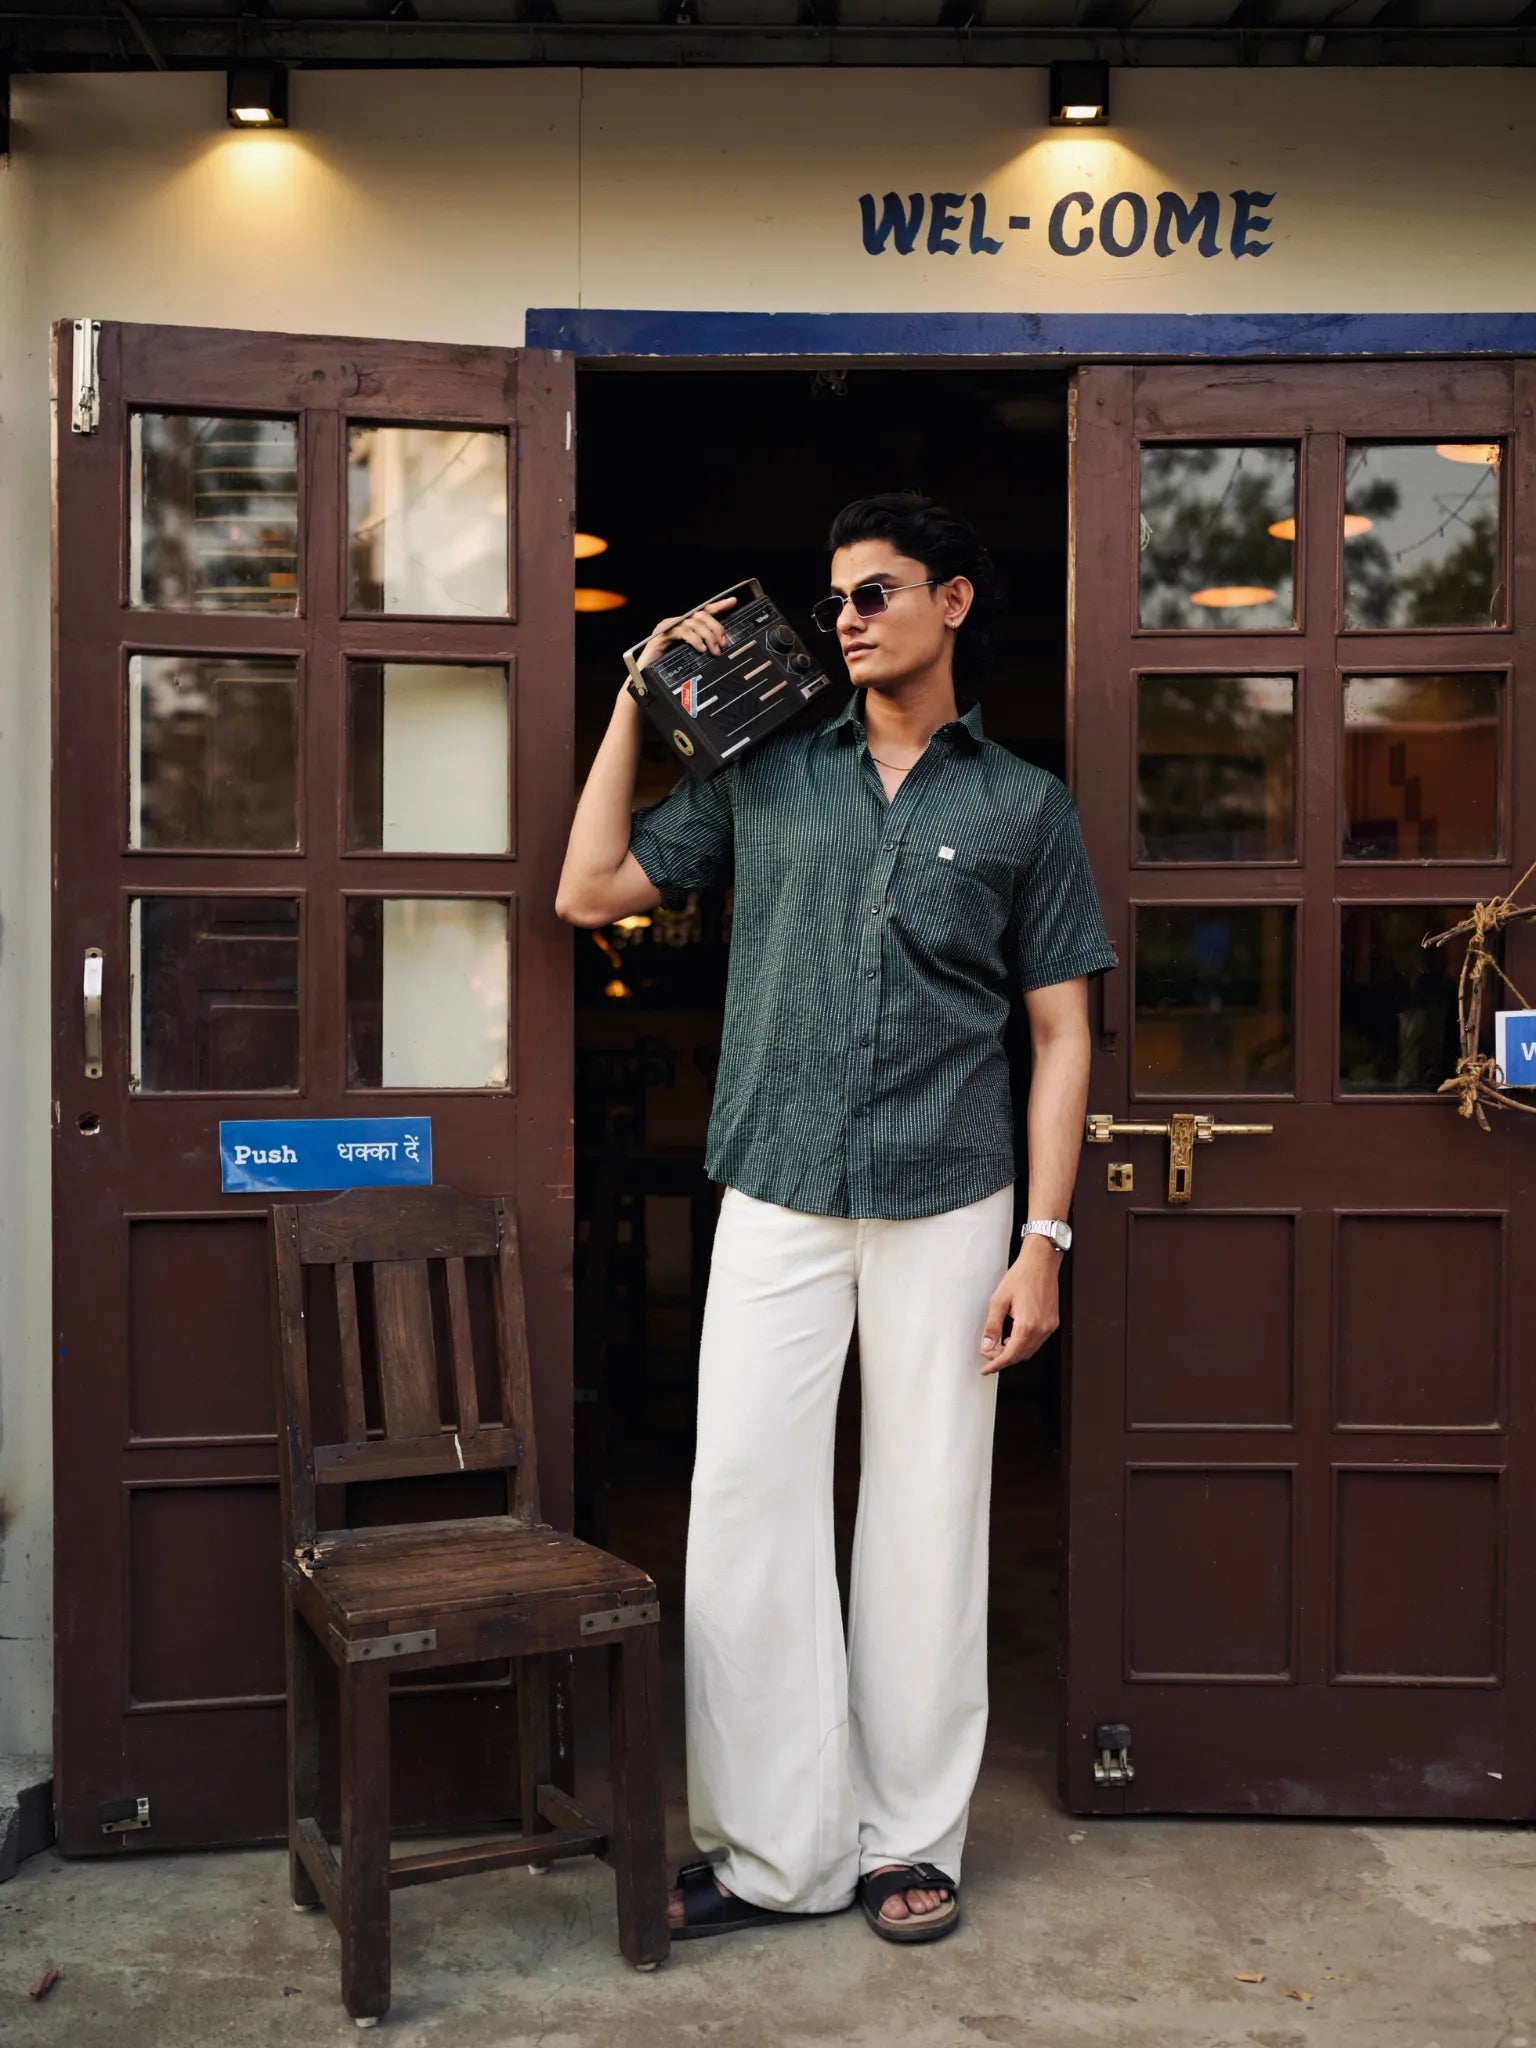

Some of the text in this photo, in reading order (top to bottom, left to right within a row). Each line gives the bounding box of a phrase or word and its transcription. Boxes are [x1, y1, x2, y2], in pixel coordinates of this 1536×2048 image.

[858, 190, 1277, 259] WEL-COME
[234, 1144, 298, 1165] Push
[337, 1134, 420, 1162] धक्का दें
